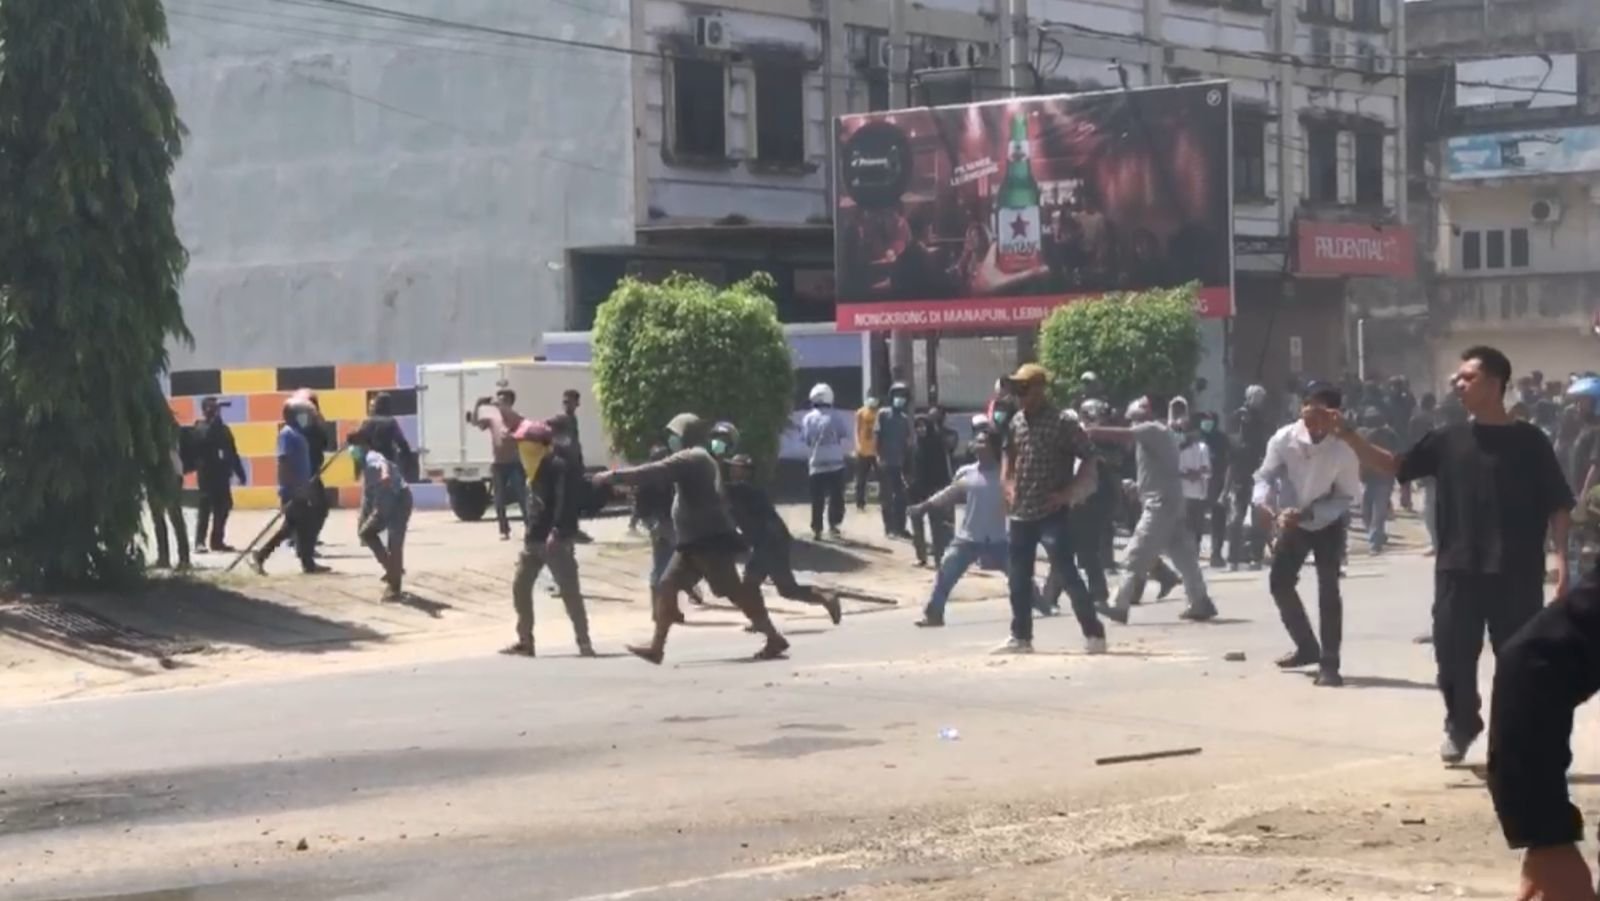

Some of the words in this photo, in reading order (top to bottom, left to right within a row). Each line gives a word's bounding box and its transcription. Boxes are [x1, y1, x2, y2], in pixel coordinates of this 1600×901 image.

[1314, 236, 1384, 260] PRUDENTIAL
[854, 311, 927, 327] NONGKRONG
[929, 311, 941, 324] DI
